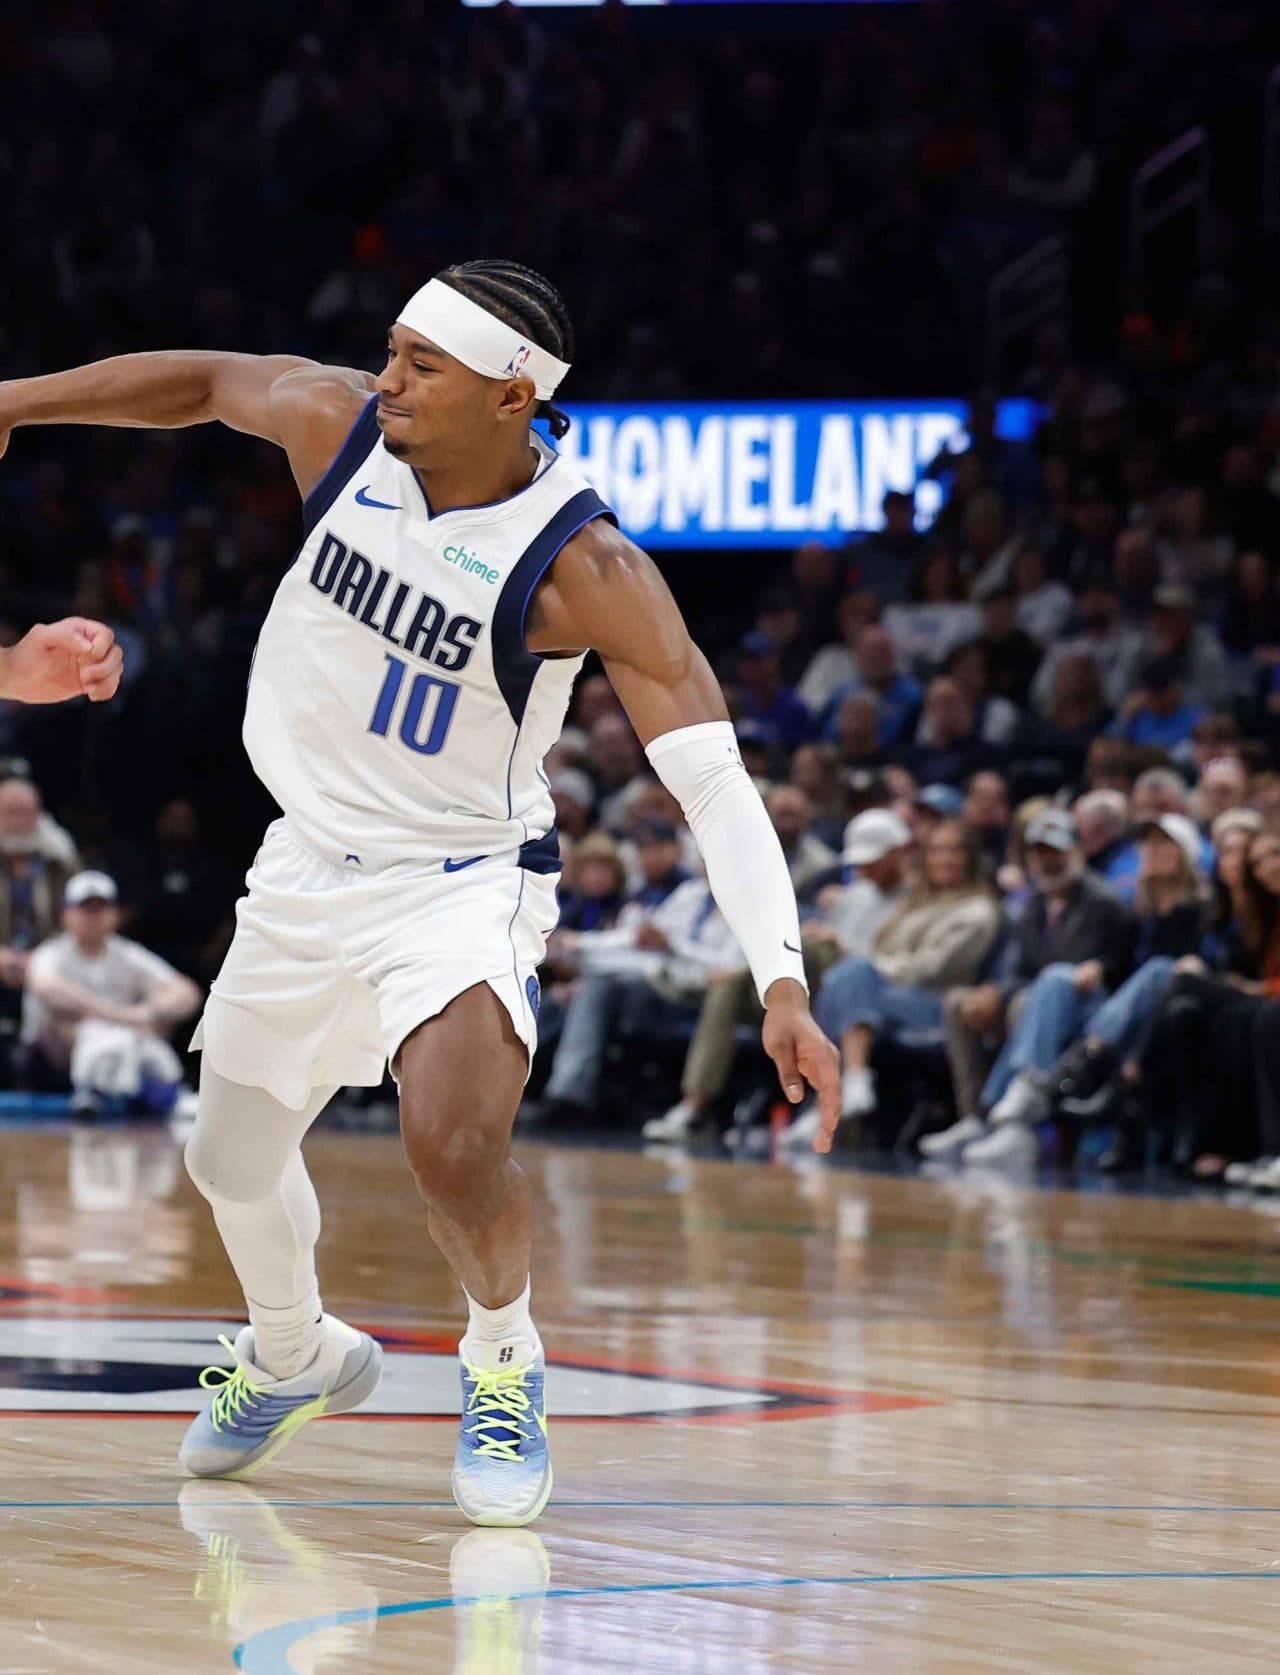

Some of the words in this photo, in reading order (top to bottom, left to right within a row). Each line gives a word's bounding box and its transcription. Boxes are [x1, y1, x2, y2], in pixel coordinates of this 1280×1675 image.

[309, 530, 485, 673] DALLAS
[443, 545, 500, 585] chime
[367, 651, 462, 756] 10
